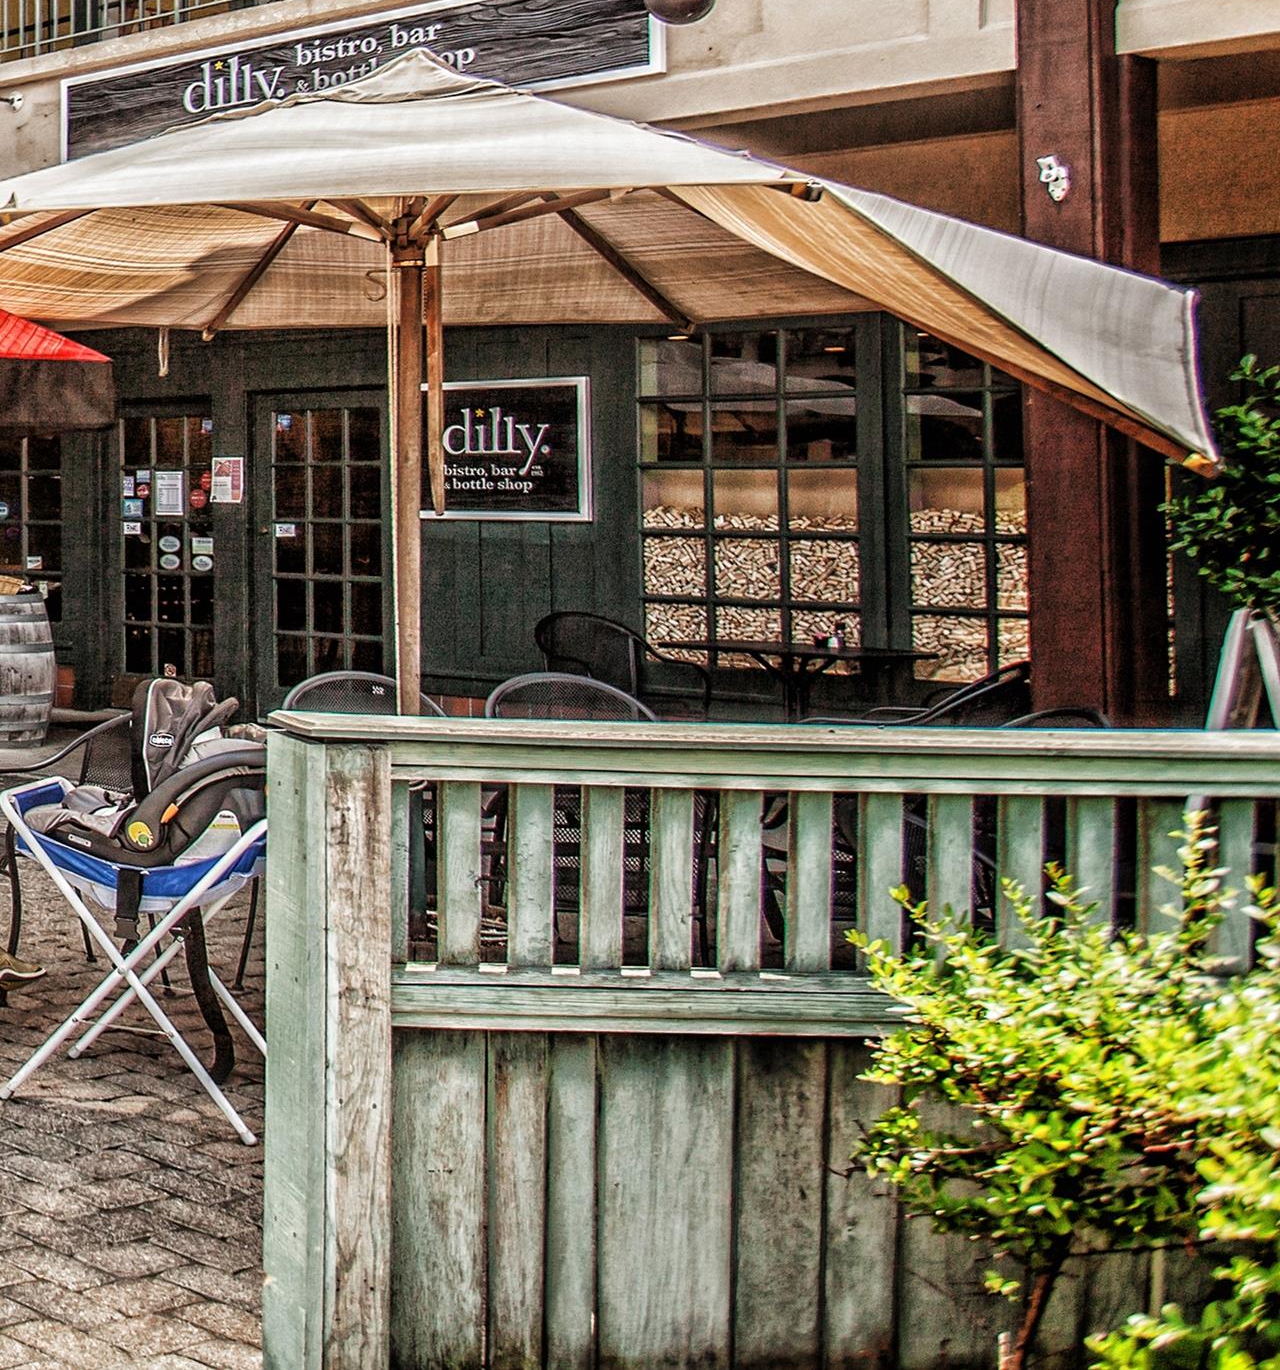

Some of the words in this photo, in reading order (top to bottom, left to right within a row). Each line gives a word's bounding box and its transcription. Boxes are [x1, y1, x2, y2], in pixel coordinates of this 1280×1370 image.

[294, 35, 383, 67] bistro,
[389, 22, 442, 48] bar
[296, 79, 310, 93] &
[313, 57, 379, 92] bottl
[442, 46, 476, 72] op
[443, 464, 489, 477] bistro,
[491, 464, 517, 476] bar
[453, 477, 495, 490] bottle
[497, 477, 533, 493] shop
